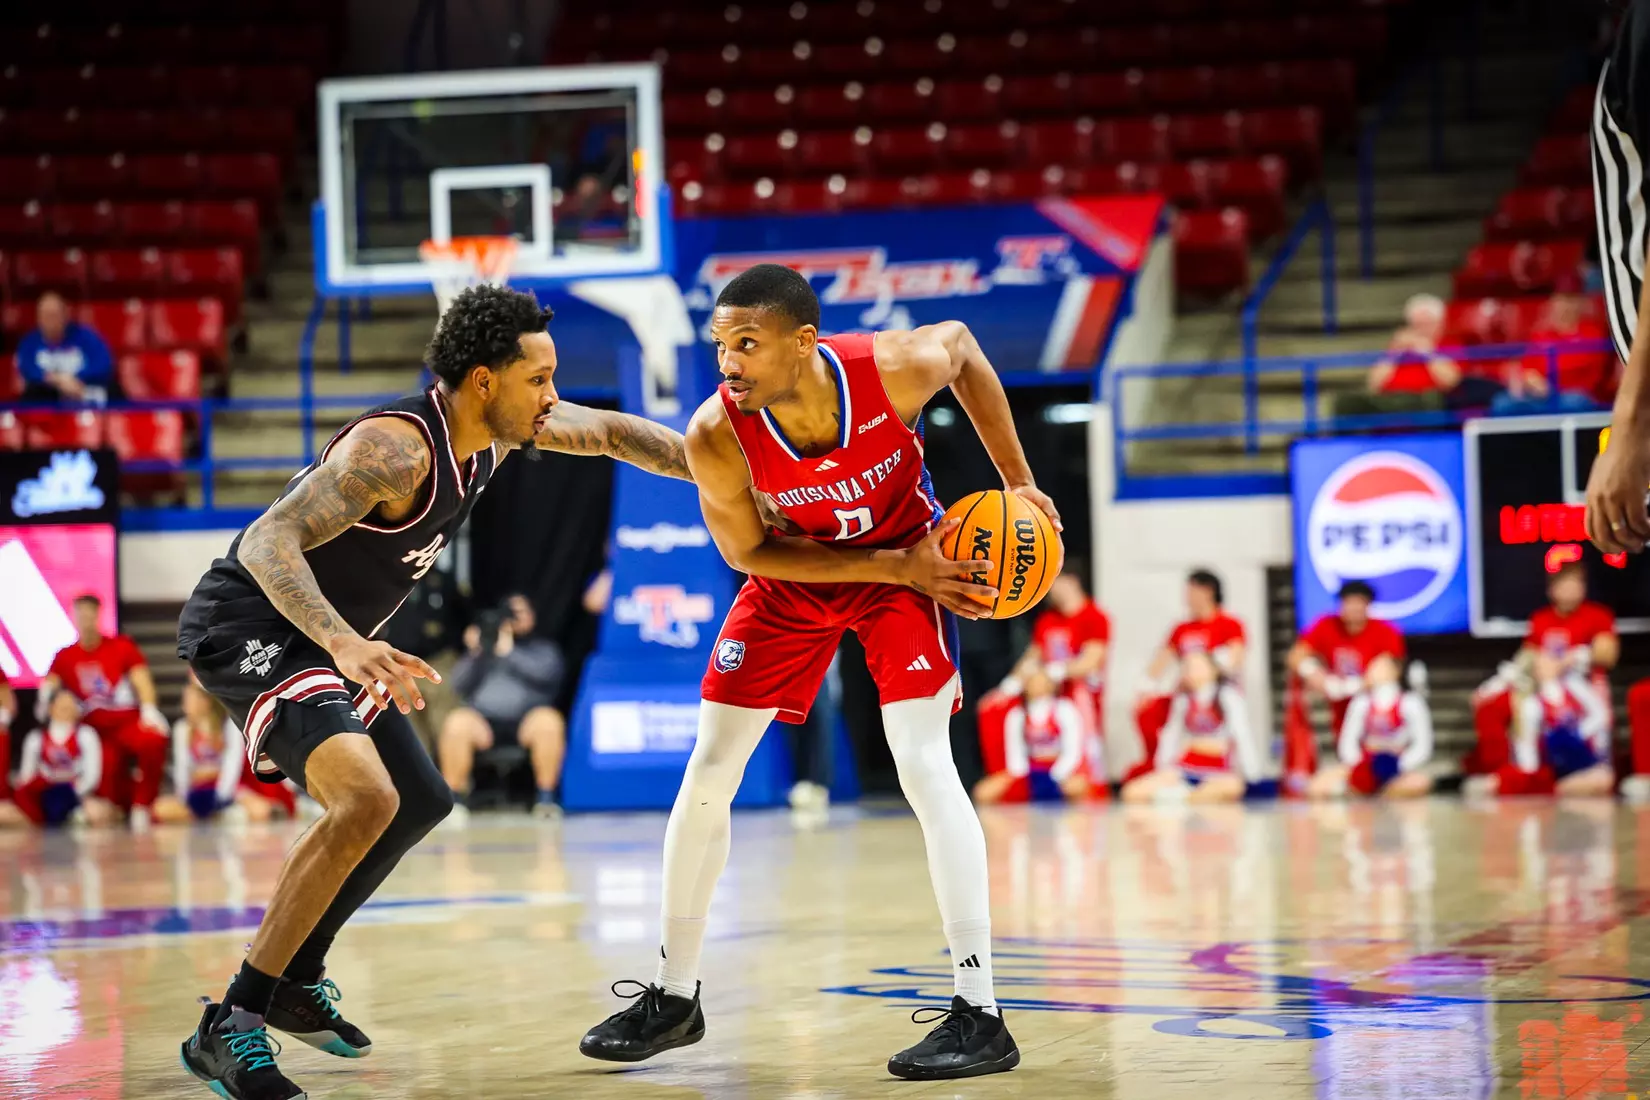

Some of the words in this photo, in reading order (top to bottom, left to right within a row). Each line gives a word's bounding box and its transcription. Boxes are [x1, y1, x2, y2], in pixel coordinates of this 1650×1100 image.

[766, 476, 866, 507] LOUISIANA
[861, 448, 901, 490] TECH
[1005, 518, 1037, 602] Wilson
[1322, 520, 1449, 551] PEPSI
